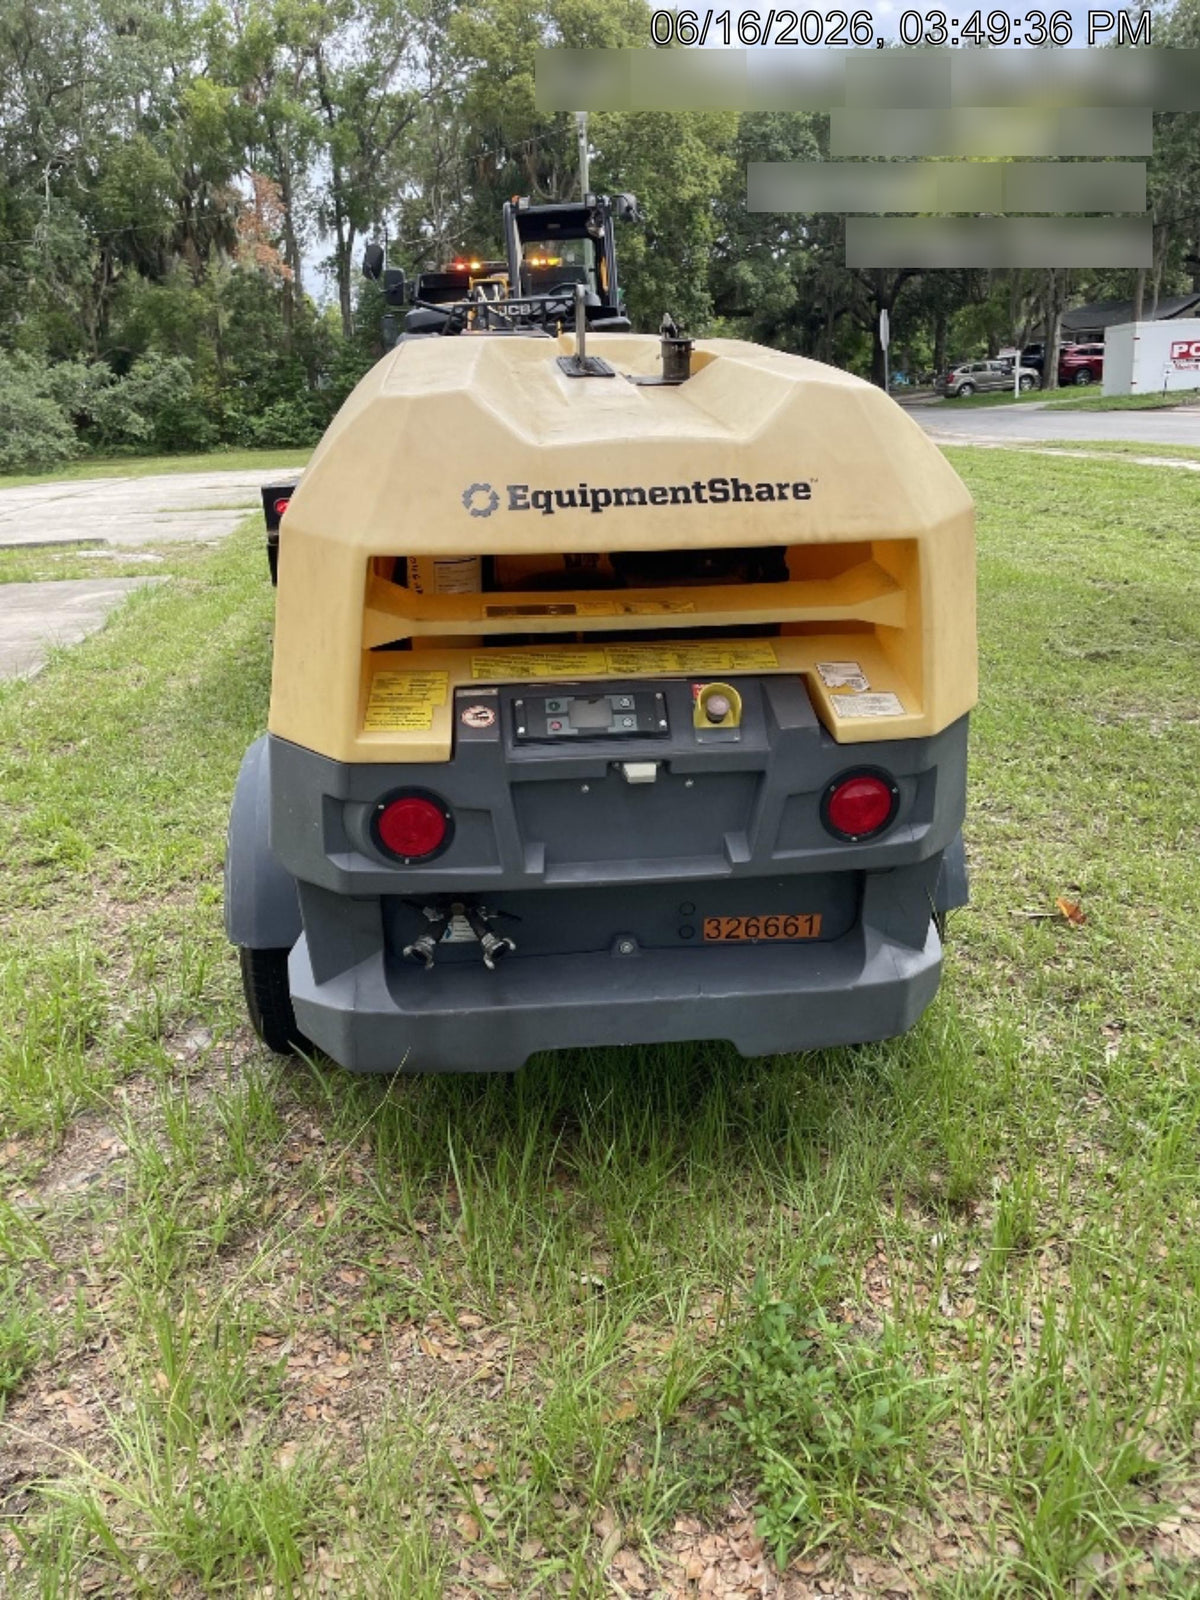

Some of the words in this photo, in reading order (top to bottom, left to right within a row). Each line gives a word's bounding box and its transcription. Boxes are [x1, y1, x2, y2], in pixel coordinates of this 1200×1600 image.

[499, 303, 531, 317] JCB
[506, 478, 812, 515] EquipmentShare
[705, 915, 814, 940] 326661
